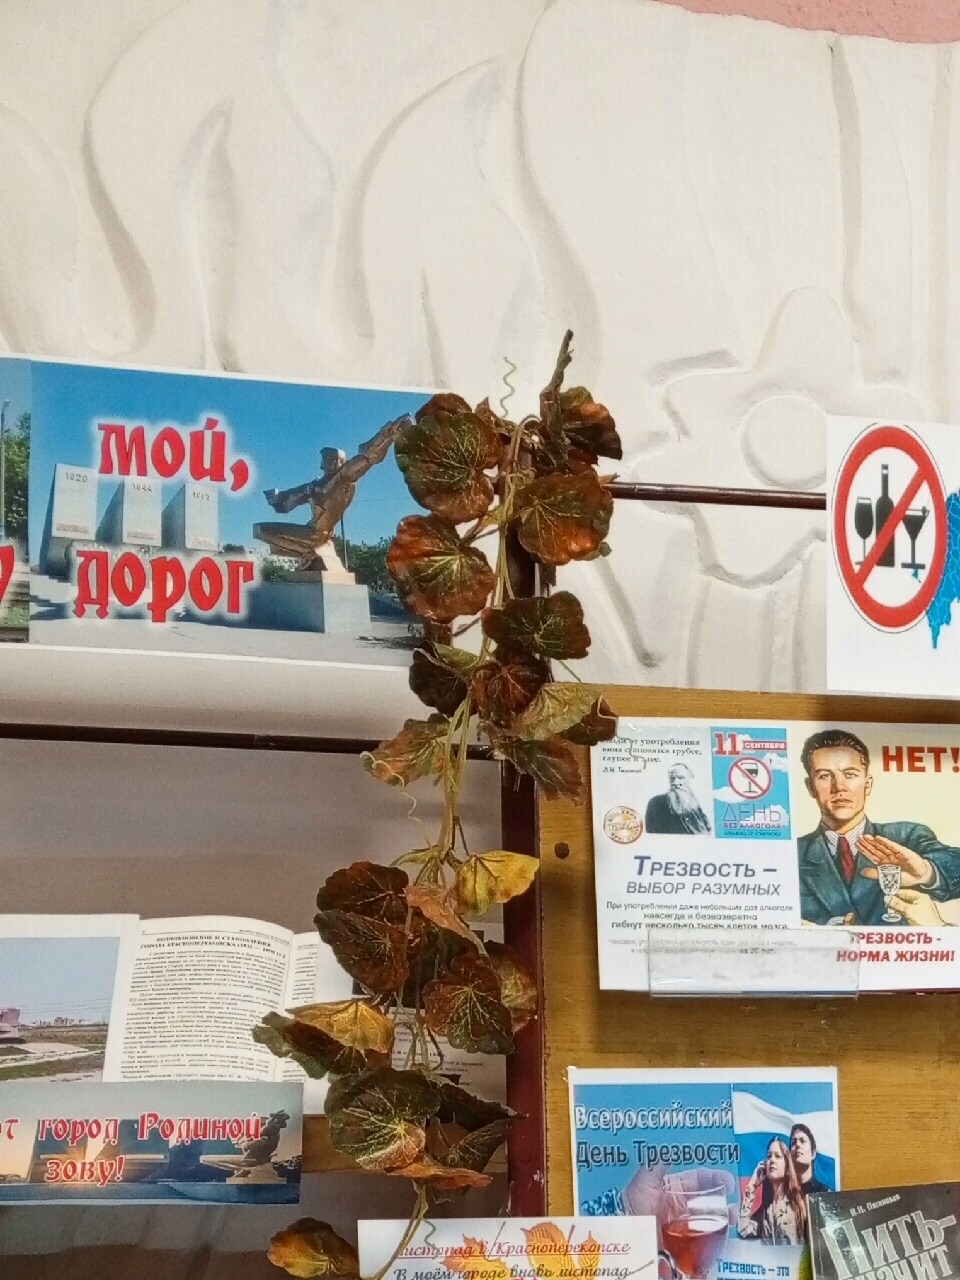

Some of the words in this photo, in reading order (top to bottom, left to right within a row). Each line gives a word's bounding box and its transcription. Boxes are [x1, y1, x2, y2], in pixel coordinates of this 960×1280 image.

[715, 732, 741, 756] 11
[743, 741, 785, 750] СЕНТЯБРЯ
[882, 746, 960, 772] НЕТ!
[723, 804, 781, 821] ДЕНЬ
[627, 882, 685, 894] ВЫБОР
[692, 883, 780, 896] РАЗУМНЫХ
[624, 903, 677, 911] употреблении
[837, 951, 890, 962] НОРМА
[894, 950, 955, 962] ЖИЗНИ!
[574, 1100, 733, 1133] Всероссийский
[39, 1118, 119, 1145] город
[138, 1113, 262, 1145] Родиной
[576, 1141, 626, 1171] День
[633, 1141, 741, 1170] Трезвости
[44, 1155, 125, 1187] зову!
[716, 1258, 766, 1276] ТРЕЗВОСТЬ
